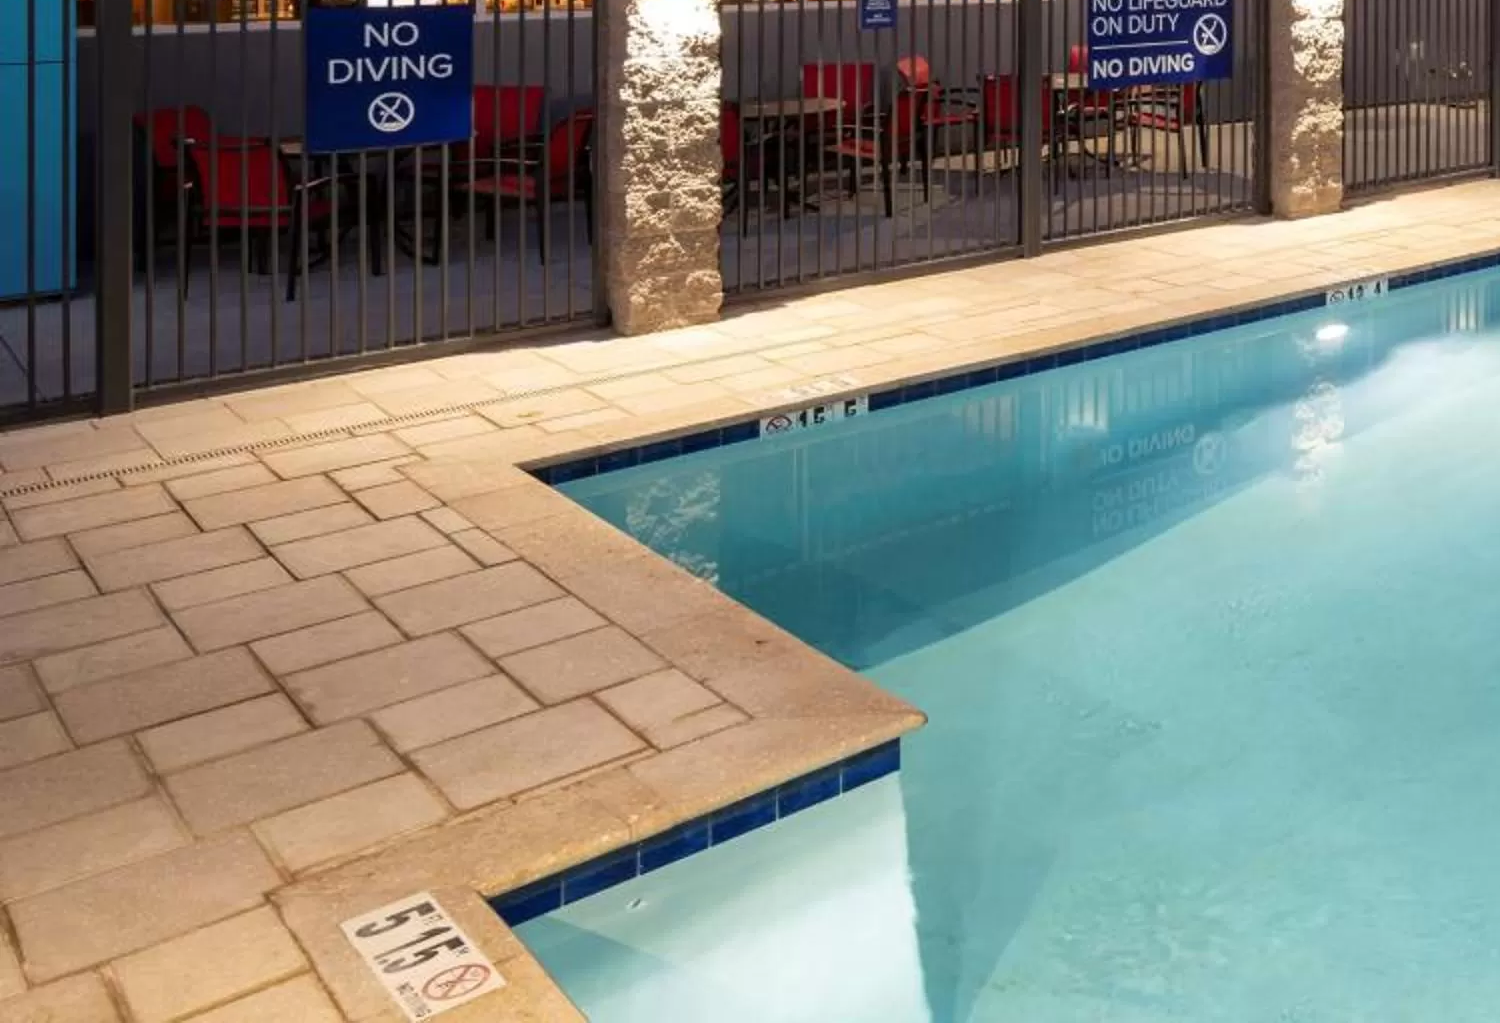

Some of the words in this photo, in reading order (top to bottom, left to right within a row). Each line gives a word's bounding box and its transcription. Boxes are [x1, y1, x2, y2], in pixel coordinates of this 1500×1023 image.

[363, 21, 419, 48] NO
[1091, 15, 1123, 37] ON
[1128, 13, 1180, 35] DUTY
[327, 53, 454, 85] DIVING
[1092, 58, 1123, 80] NO
[1129, 52, 1196, 76] DIVING
[355, 901, 437, 938] 5
